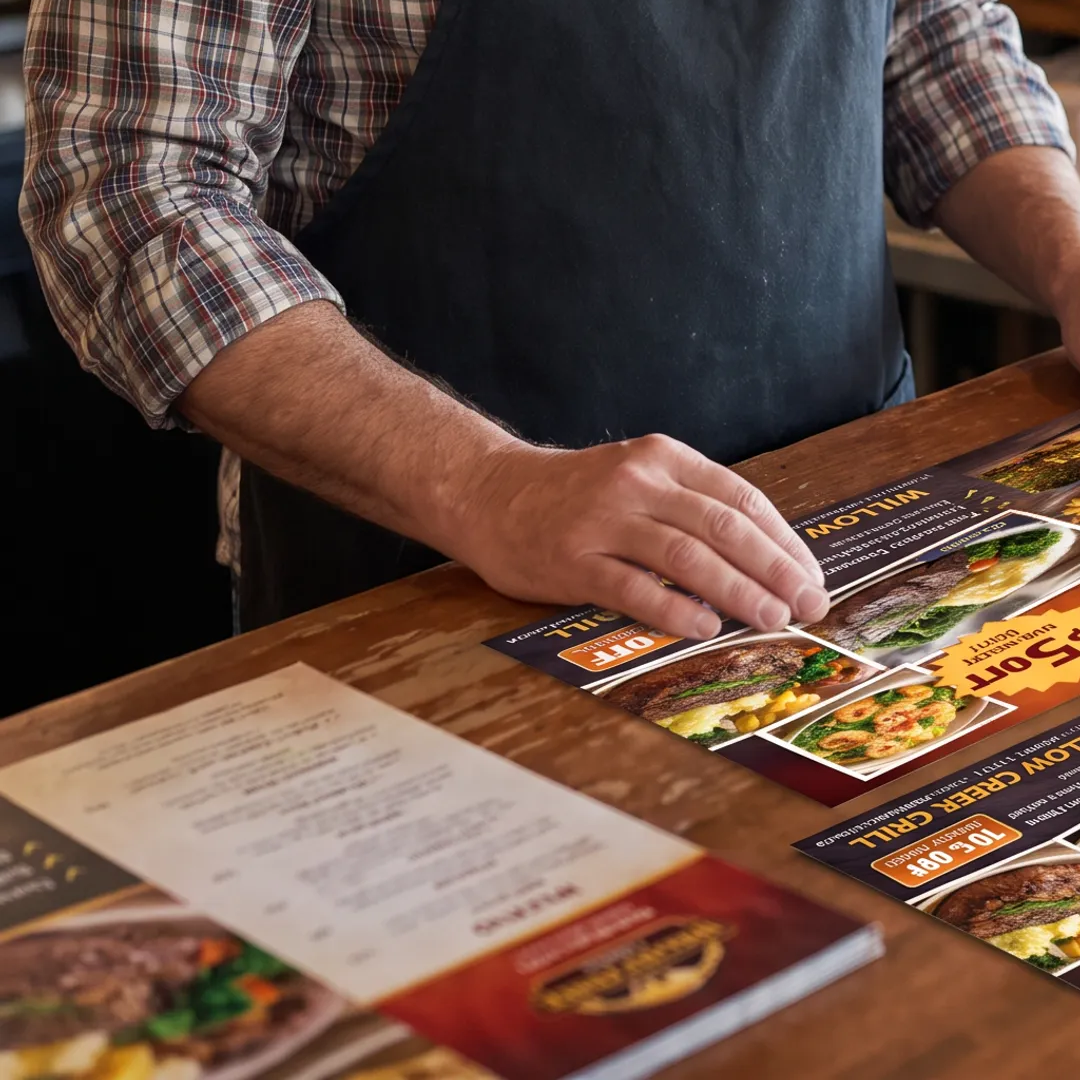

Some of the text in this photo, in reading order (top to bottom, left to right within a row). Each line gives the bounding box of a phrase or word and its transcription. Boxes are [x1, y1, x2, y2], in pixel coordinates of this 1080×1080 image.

[806, 489, 930, 538] WILLOW
[591, 636, 654, 666] OFF
[848, 811, 932, 848] GRILL
